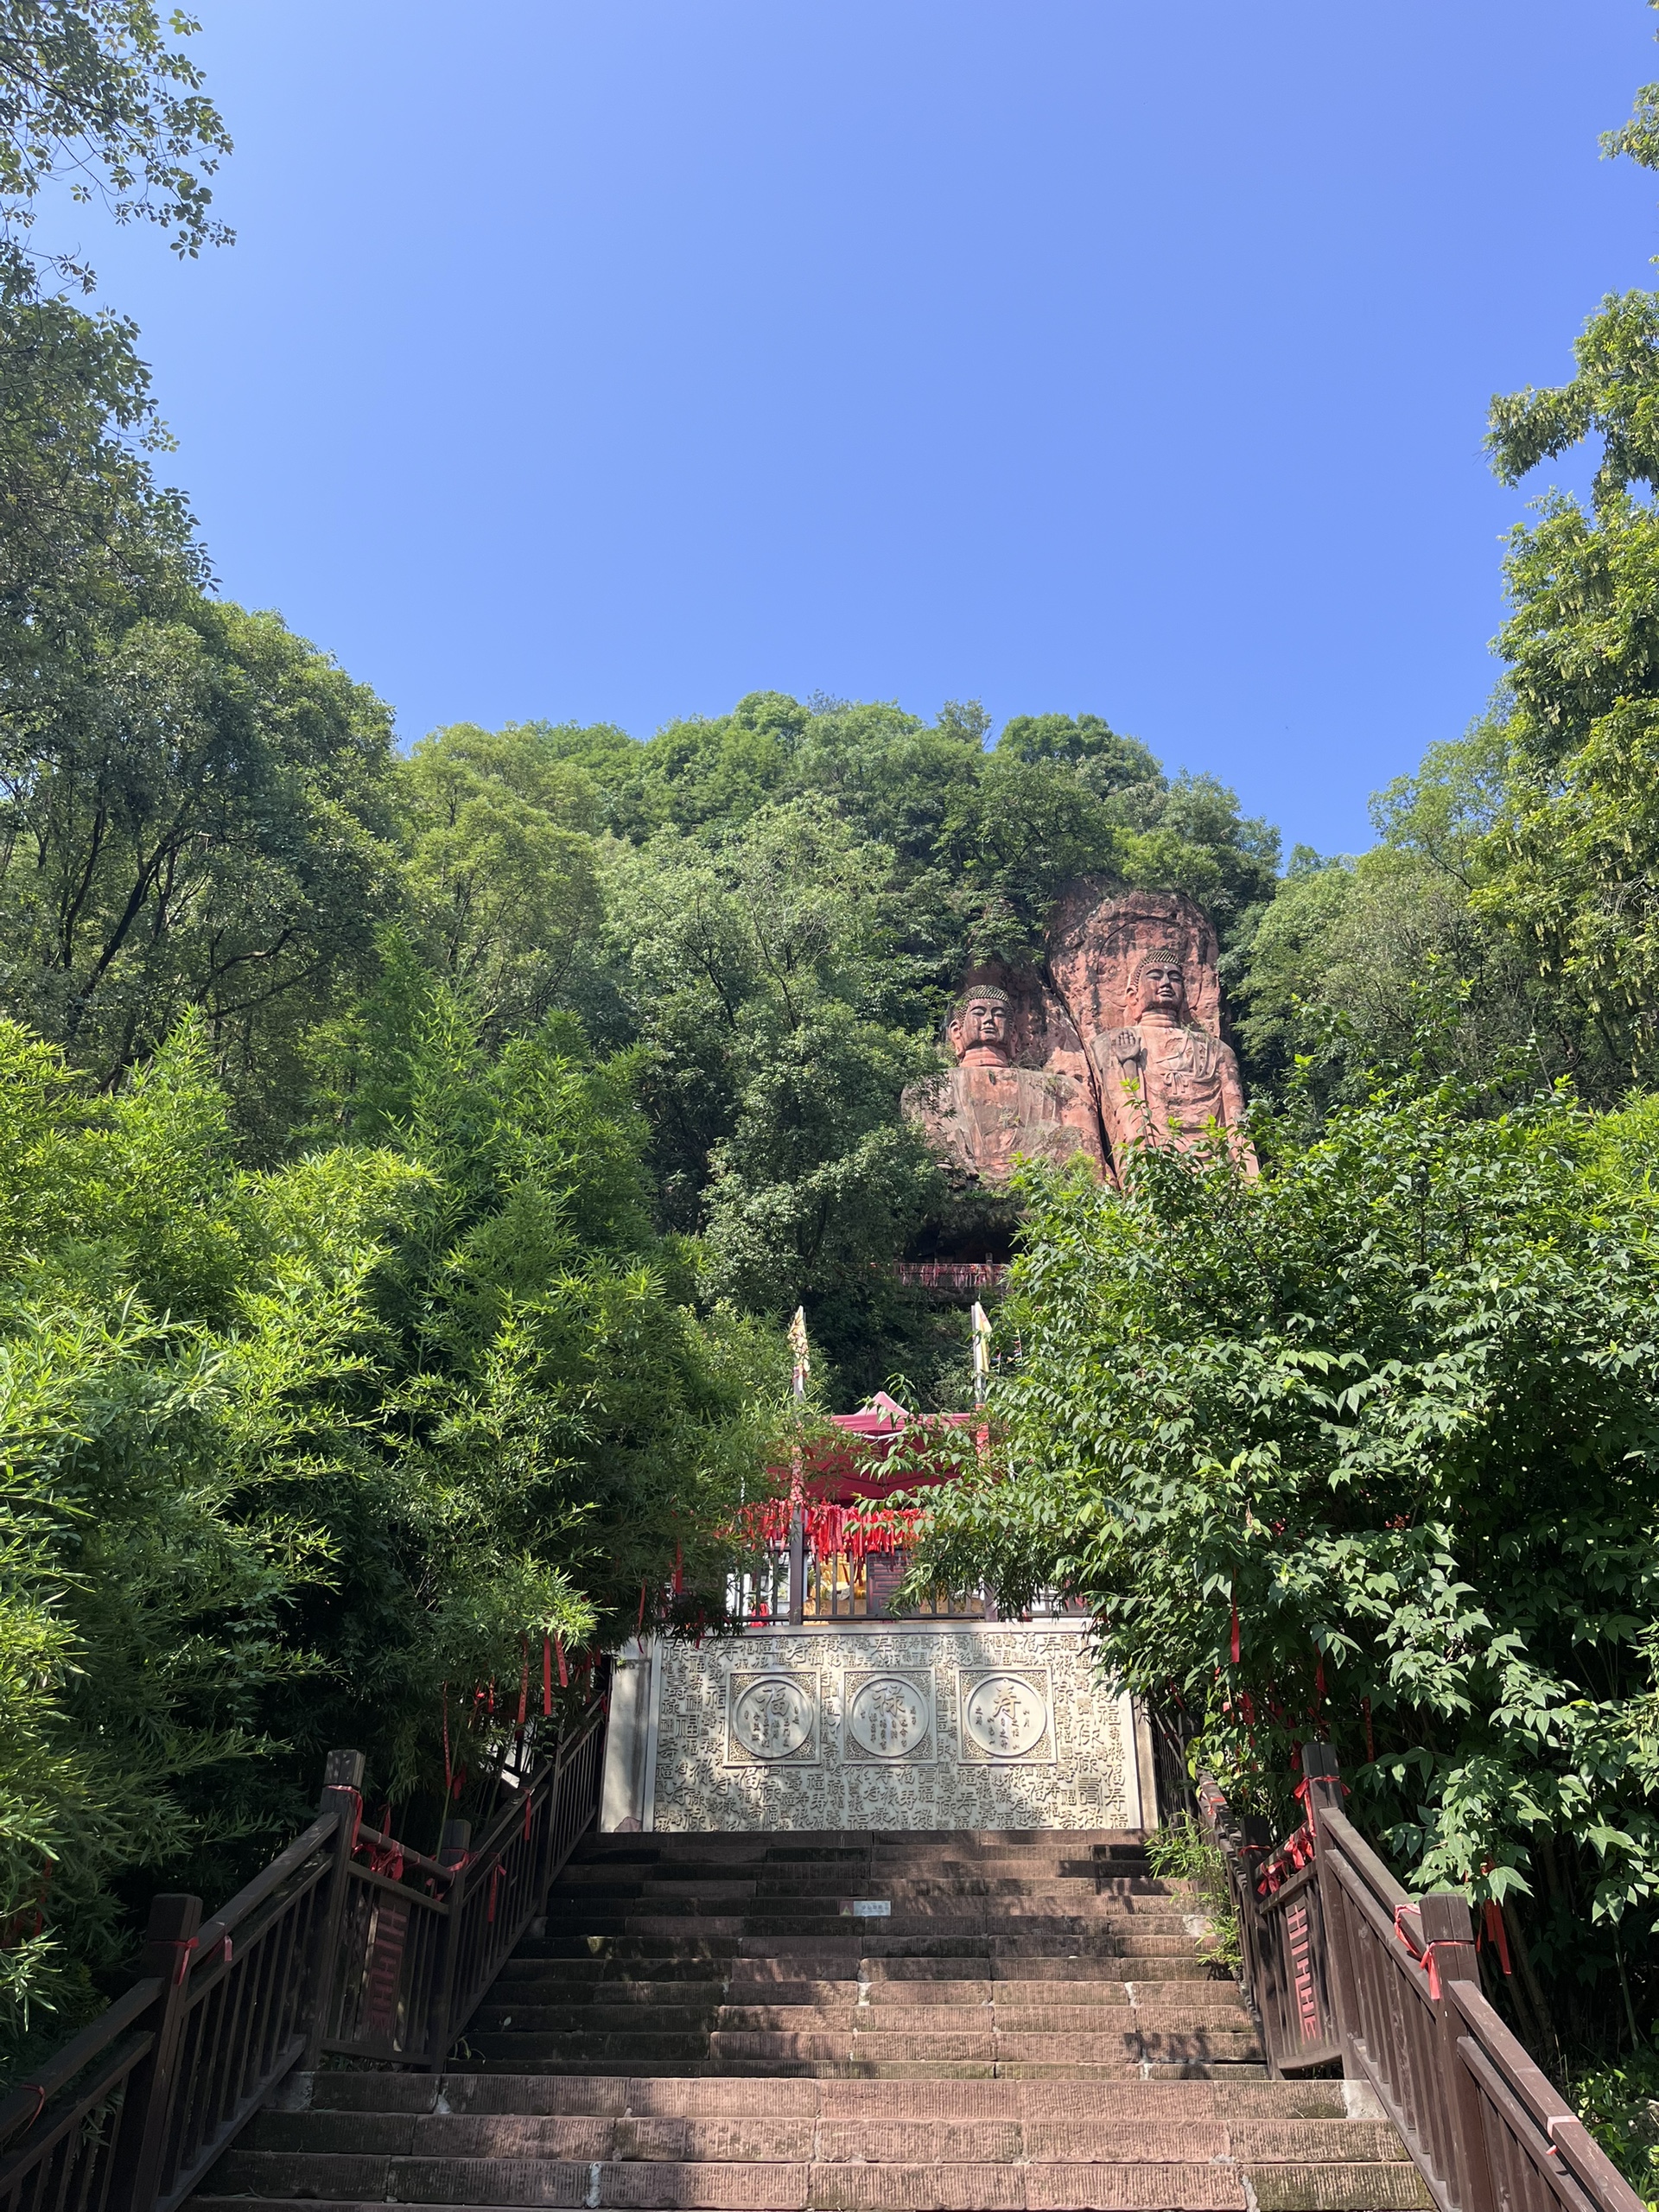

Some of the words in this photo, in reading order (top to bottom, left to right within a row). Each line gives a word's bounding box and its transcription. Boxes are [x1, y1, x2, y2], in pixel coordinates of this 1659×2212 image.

[755, 1686, 789, 1717] 福
[872, 1682, 906, 1717] 禄
[994, 1678, 1021, 1719] 寿
